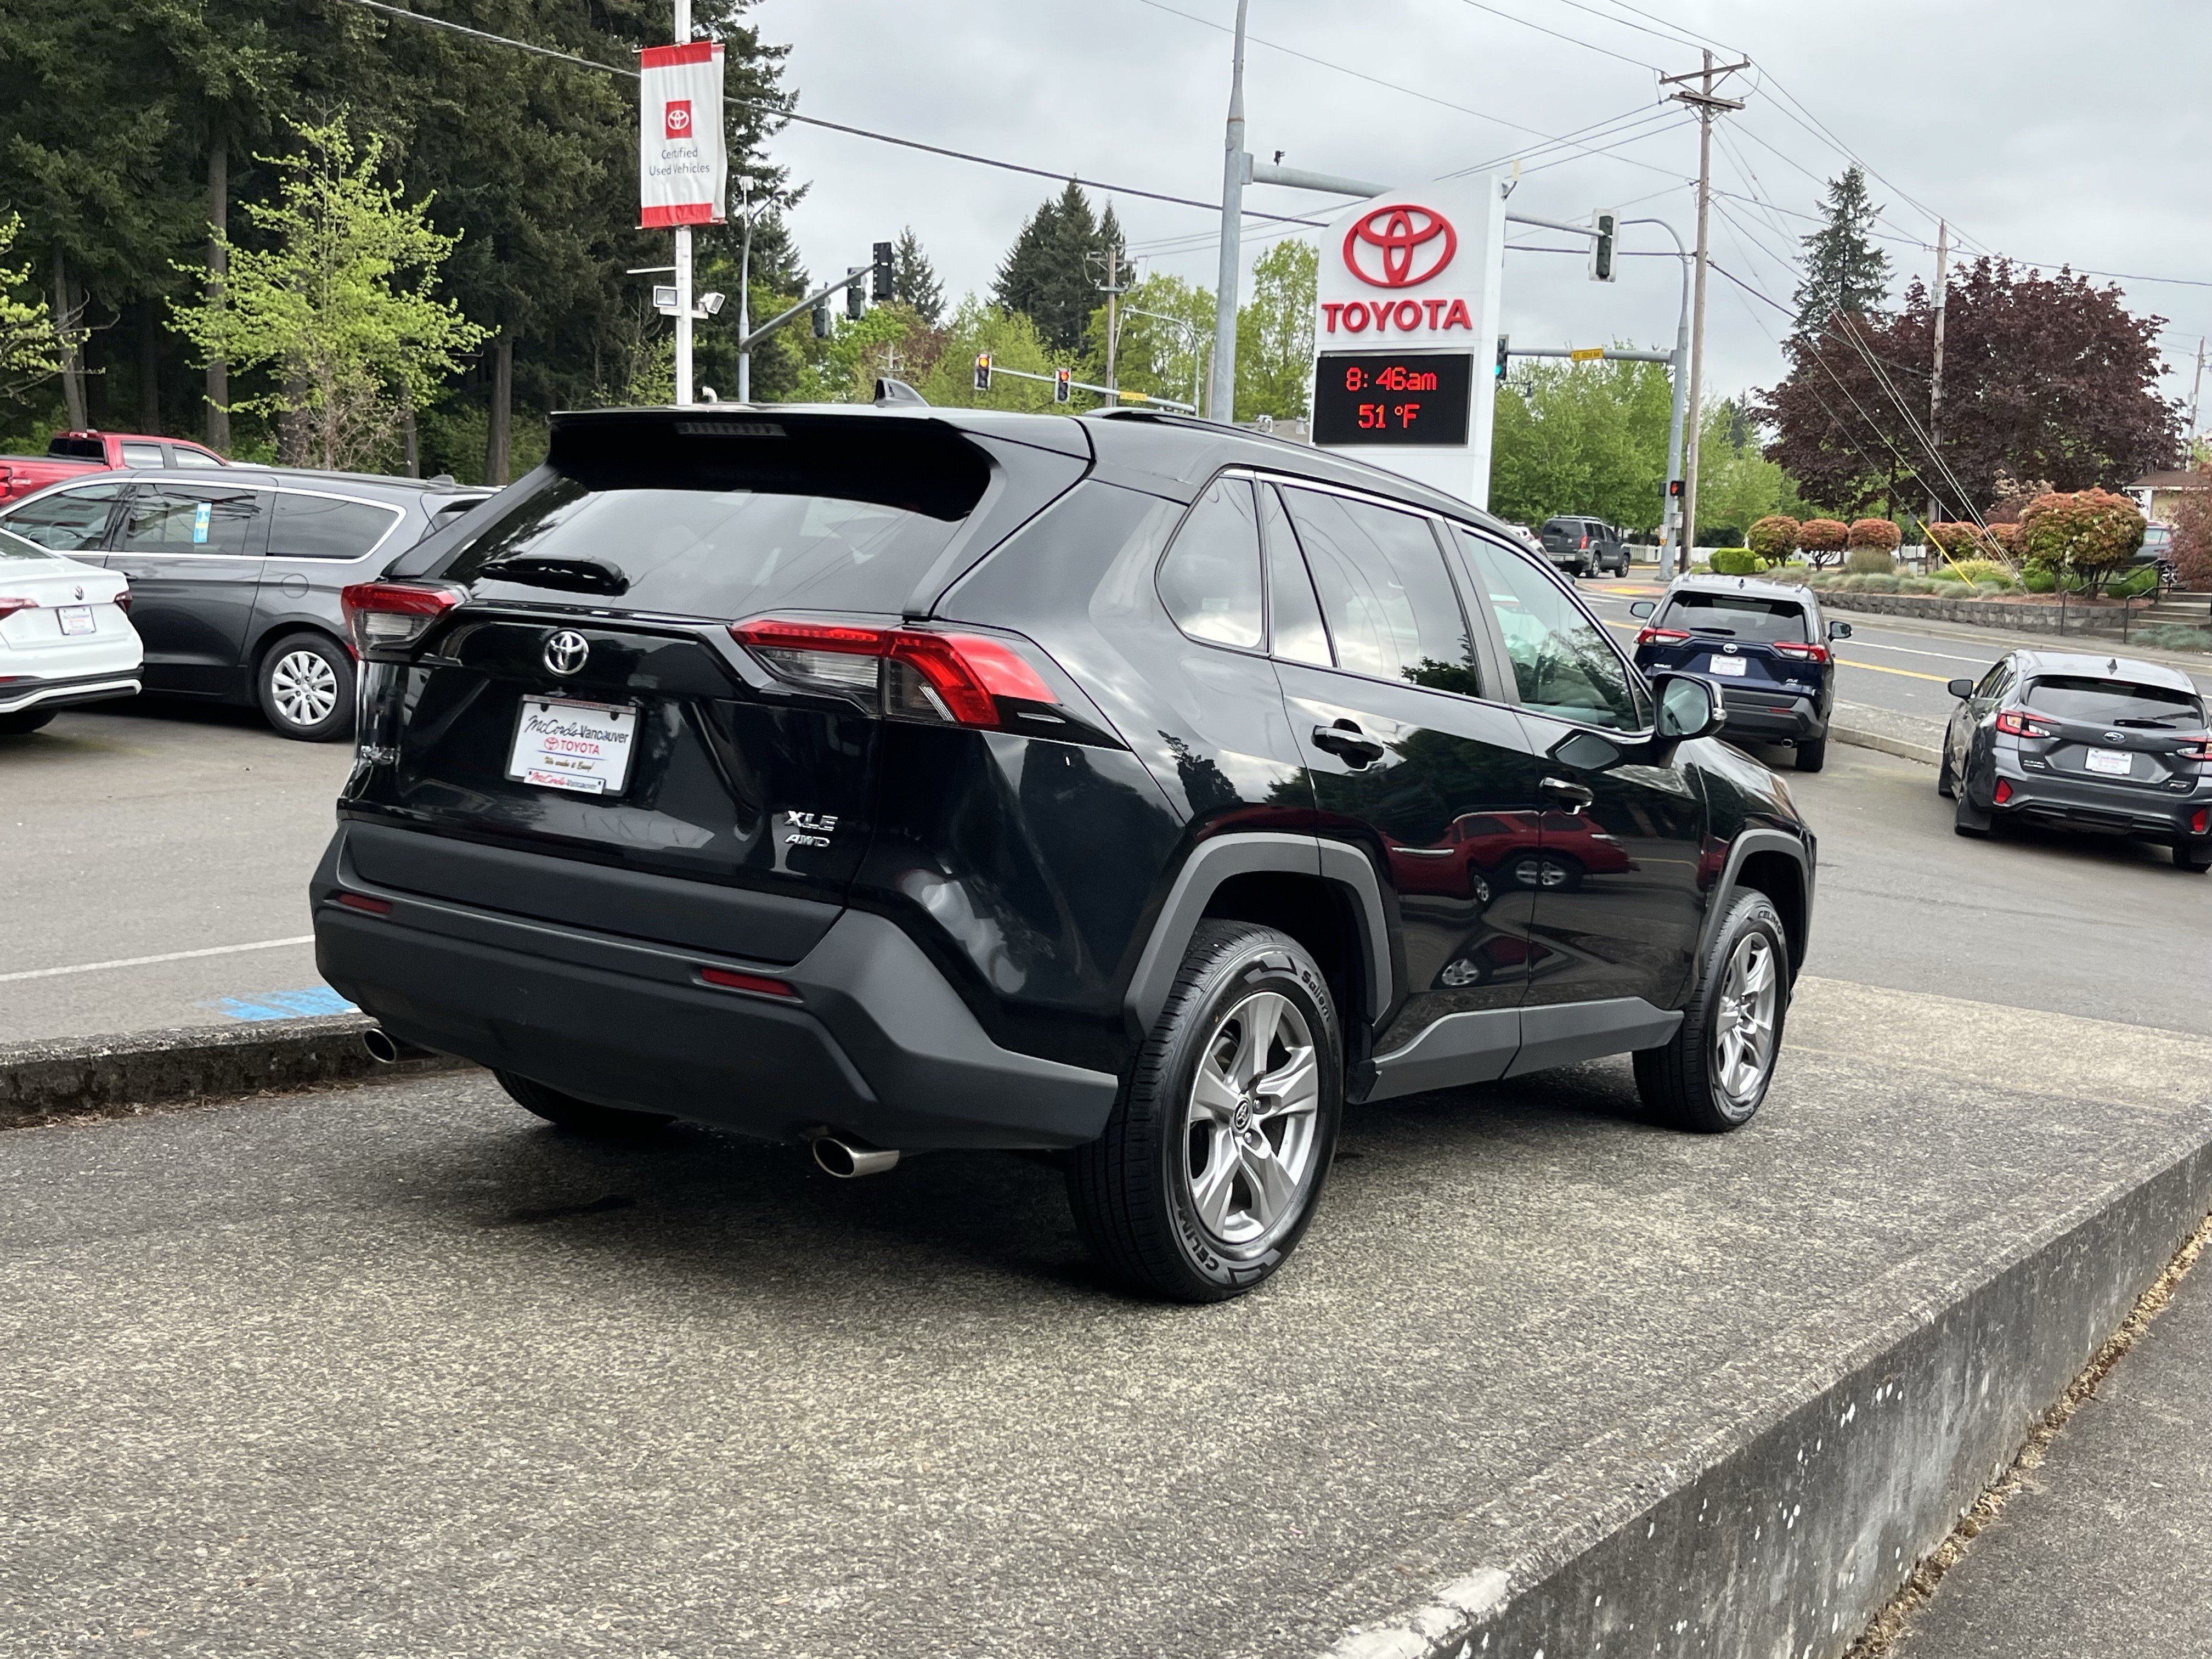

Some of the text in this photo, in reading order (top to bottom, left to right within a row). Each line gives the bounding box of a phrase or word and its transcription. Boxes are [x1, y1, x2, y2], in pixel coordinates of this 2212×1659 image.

[662, 146, 698, 160] Certified
[649, 163, 710, 176] Used Vehicles
[1322, 300, 1473, 333] TOYOTA
[581, 725, 629, 743] Vancouver
[561, 740, 600, 755] TOYOTA
[784, 810, 838, 831] XLE
[785, 834, 830, 847] AWD
